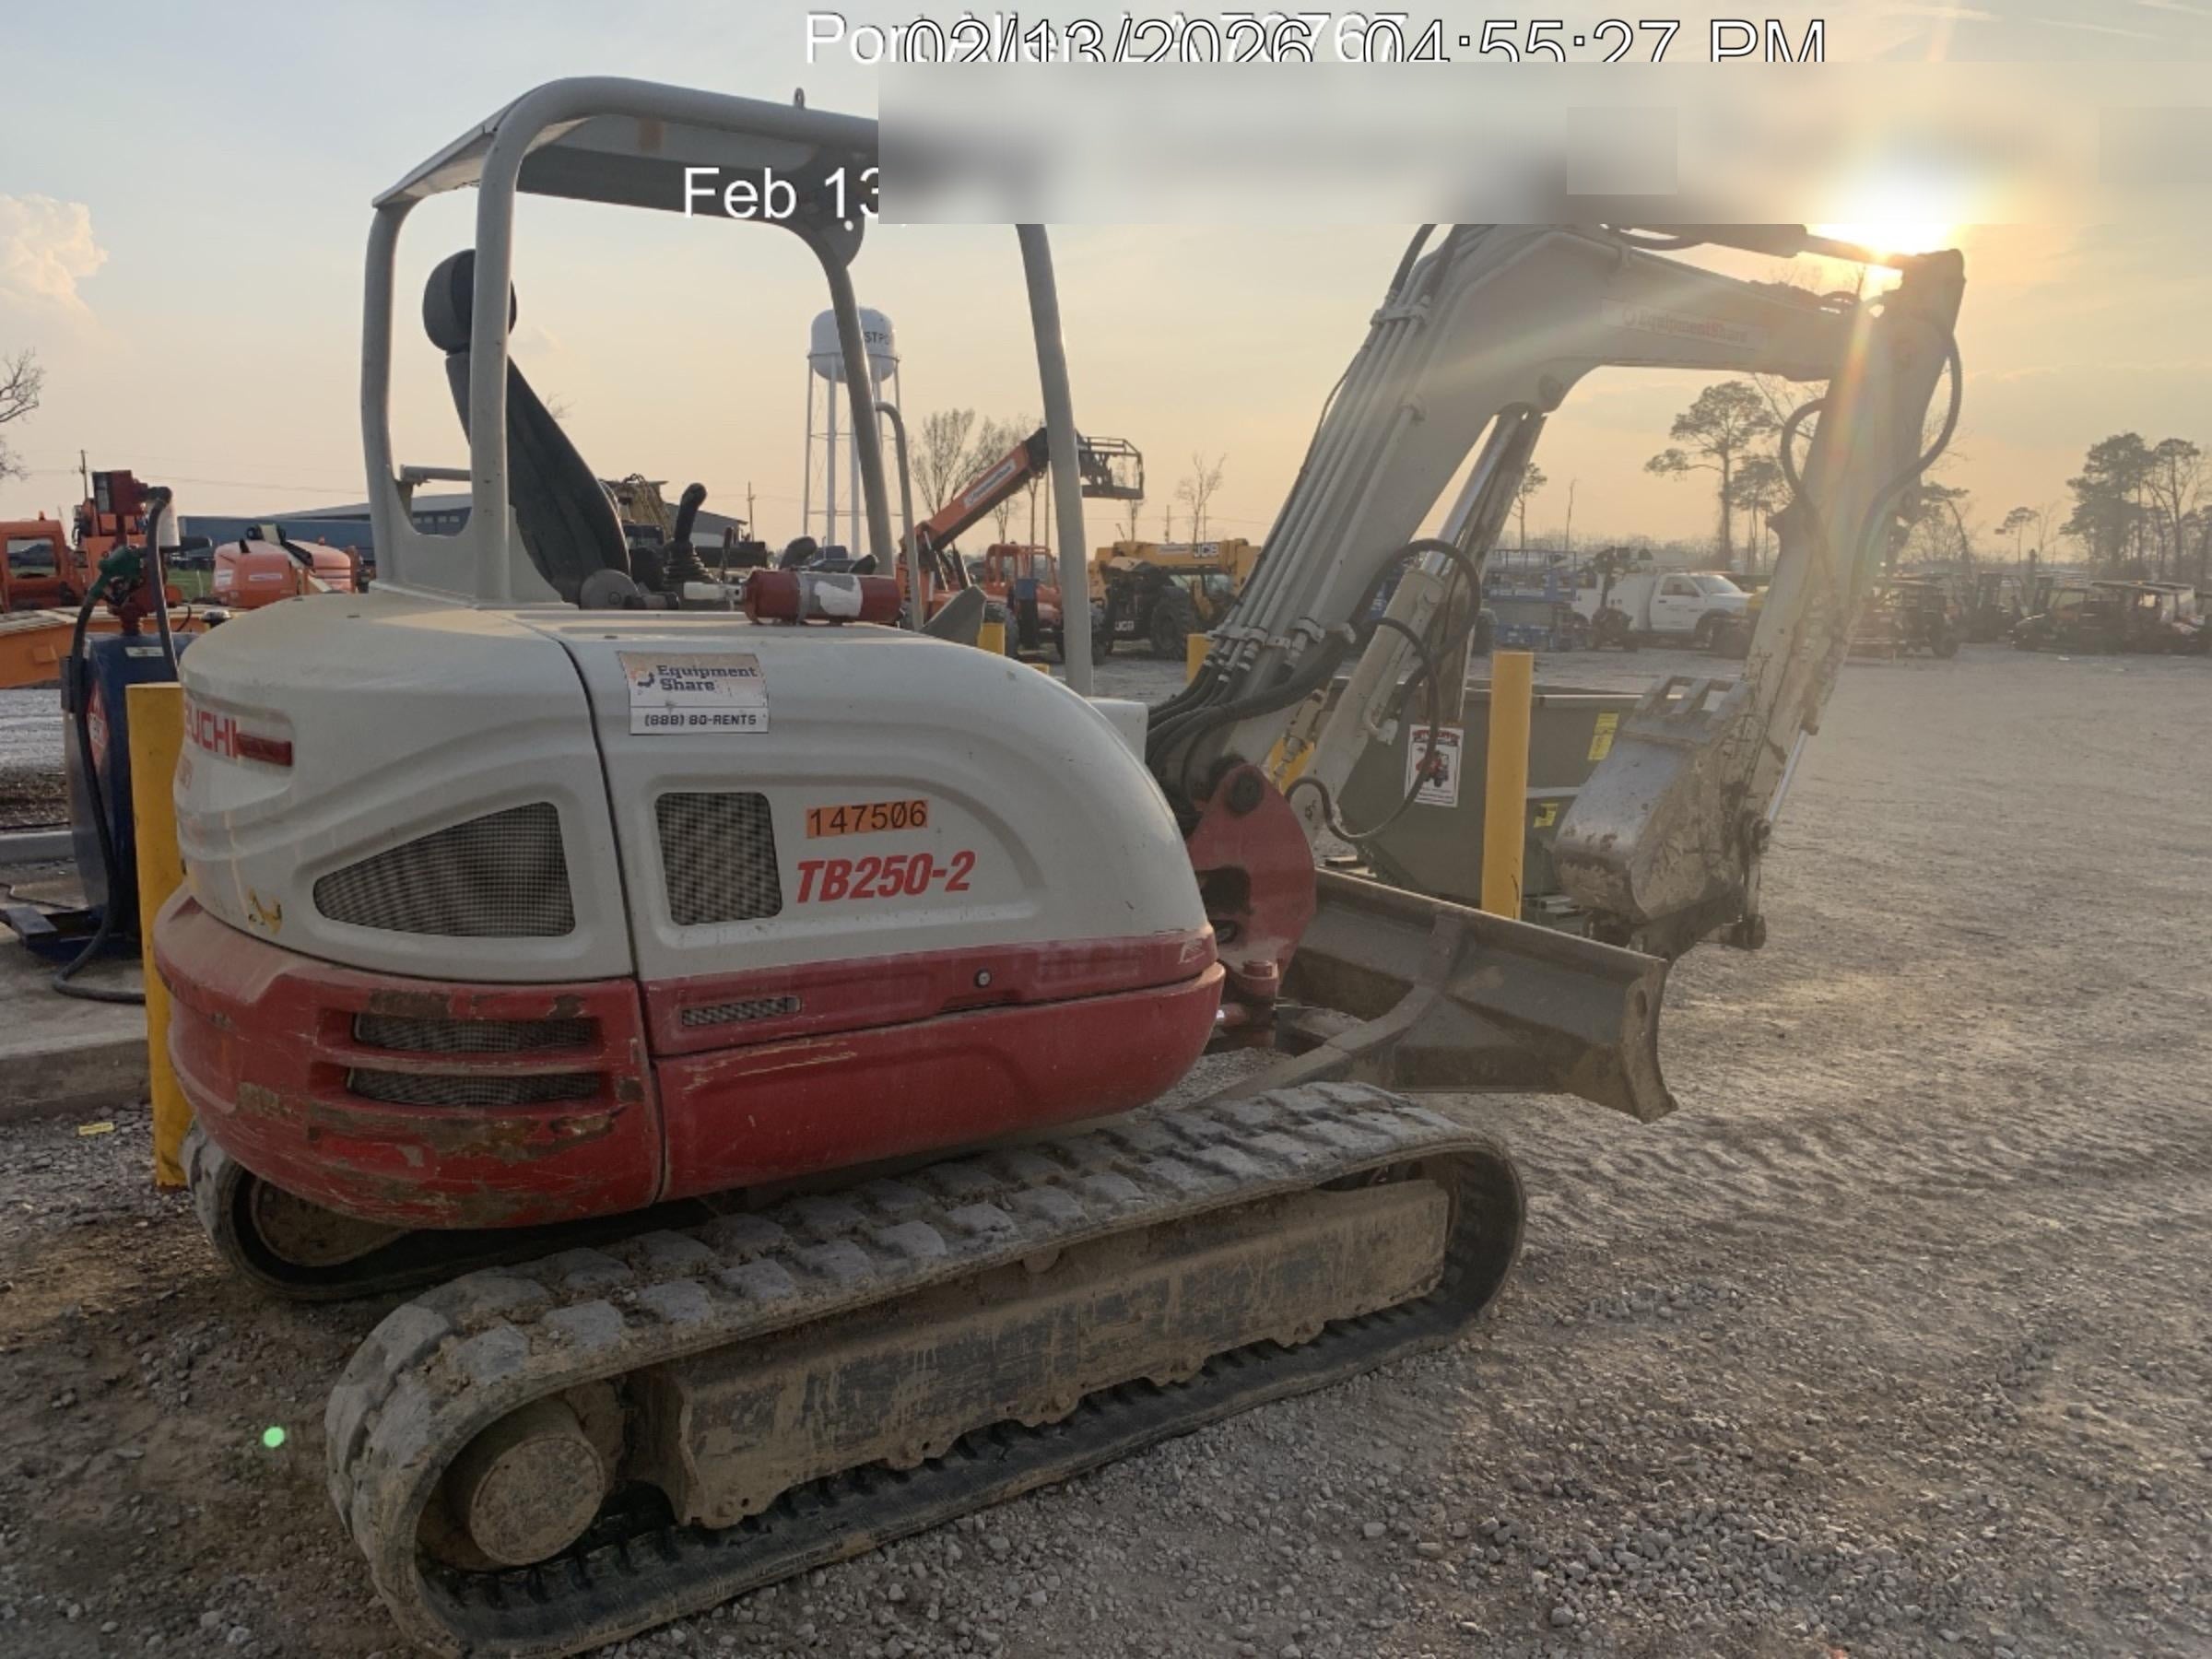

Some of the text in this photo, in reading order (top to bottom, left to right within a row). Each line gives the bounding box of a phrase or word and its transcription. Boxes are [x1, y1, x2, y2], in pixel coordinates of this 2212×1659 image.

[656, 664, 758, 679] Equipment
[660, 677, 715, 692] Share
[644, 713, 685, 727] (888)
[809, 799, 927, 837] 147506
[796, 850, 976, 904] TB250-2
